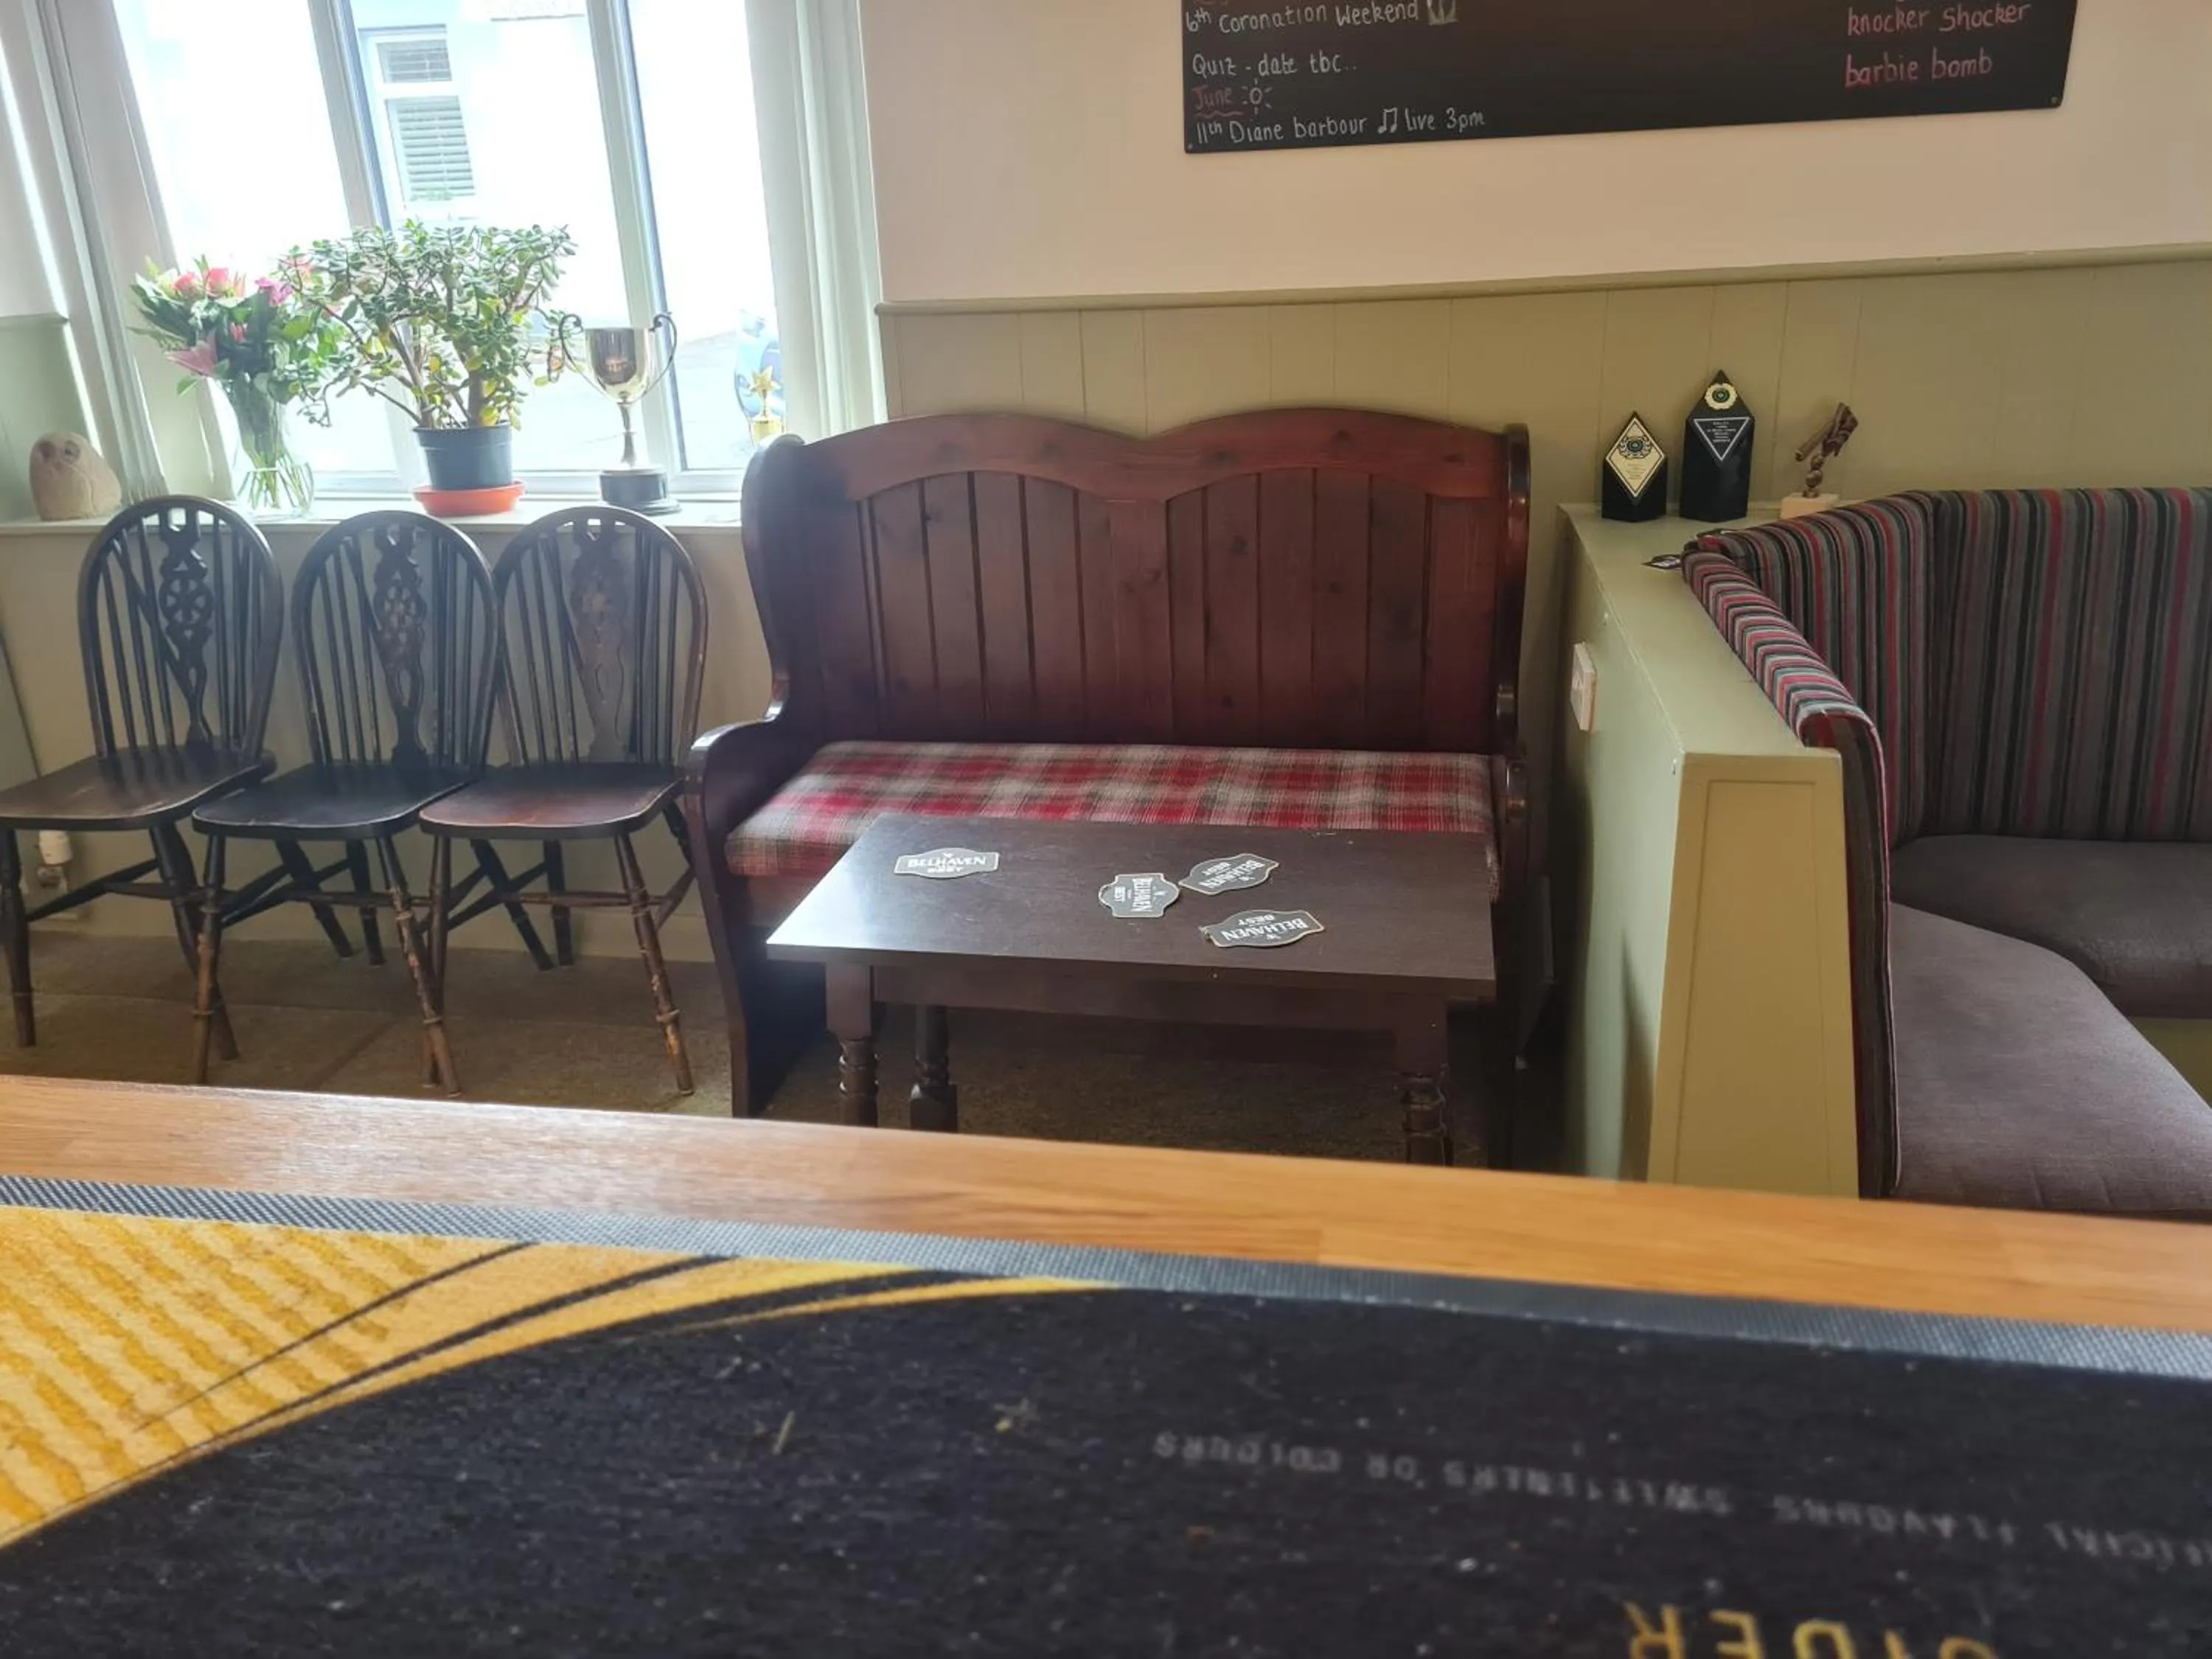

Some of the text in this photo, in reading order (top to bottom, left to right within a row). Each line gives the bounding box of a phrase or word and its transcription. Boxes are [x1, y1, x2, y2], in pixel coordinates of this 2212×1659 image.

[1185, 1, 1419, 35] 6th Coronation Weekend
[1846, 6, 1930, 37] knocker
[1192, 53, 1237, 77] Quiz
[1258, 52, 1298, 77] date
[1844, 46, 1993, 88] barbie bomb
[1191, 85, 1234, 111] June
[1196, 108, 1486, 145] 11th Diane barbour live 3pm
[908, 856, 987, 867] BELHAVEN
[1221, 917, 1309, 942] BELHAVEN
[1624, 1601, 1997, 1659] DER
